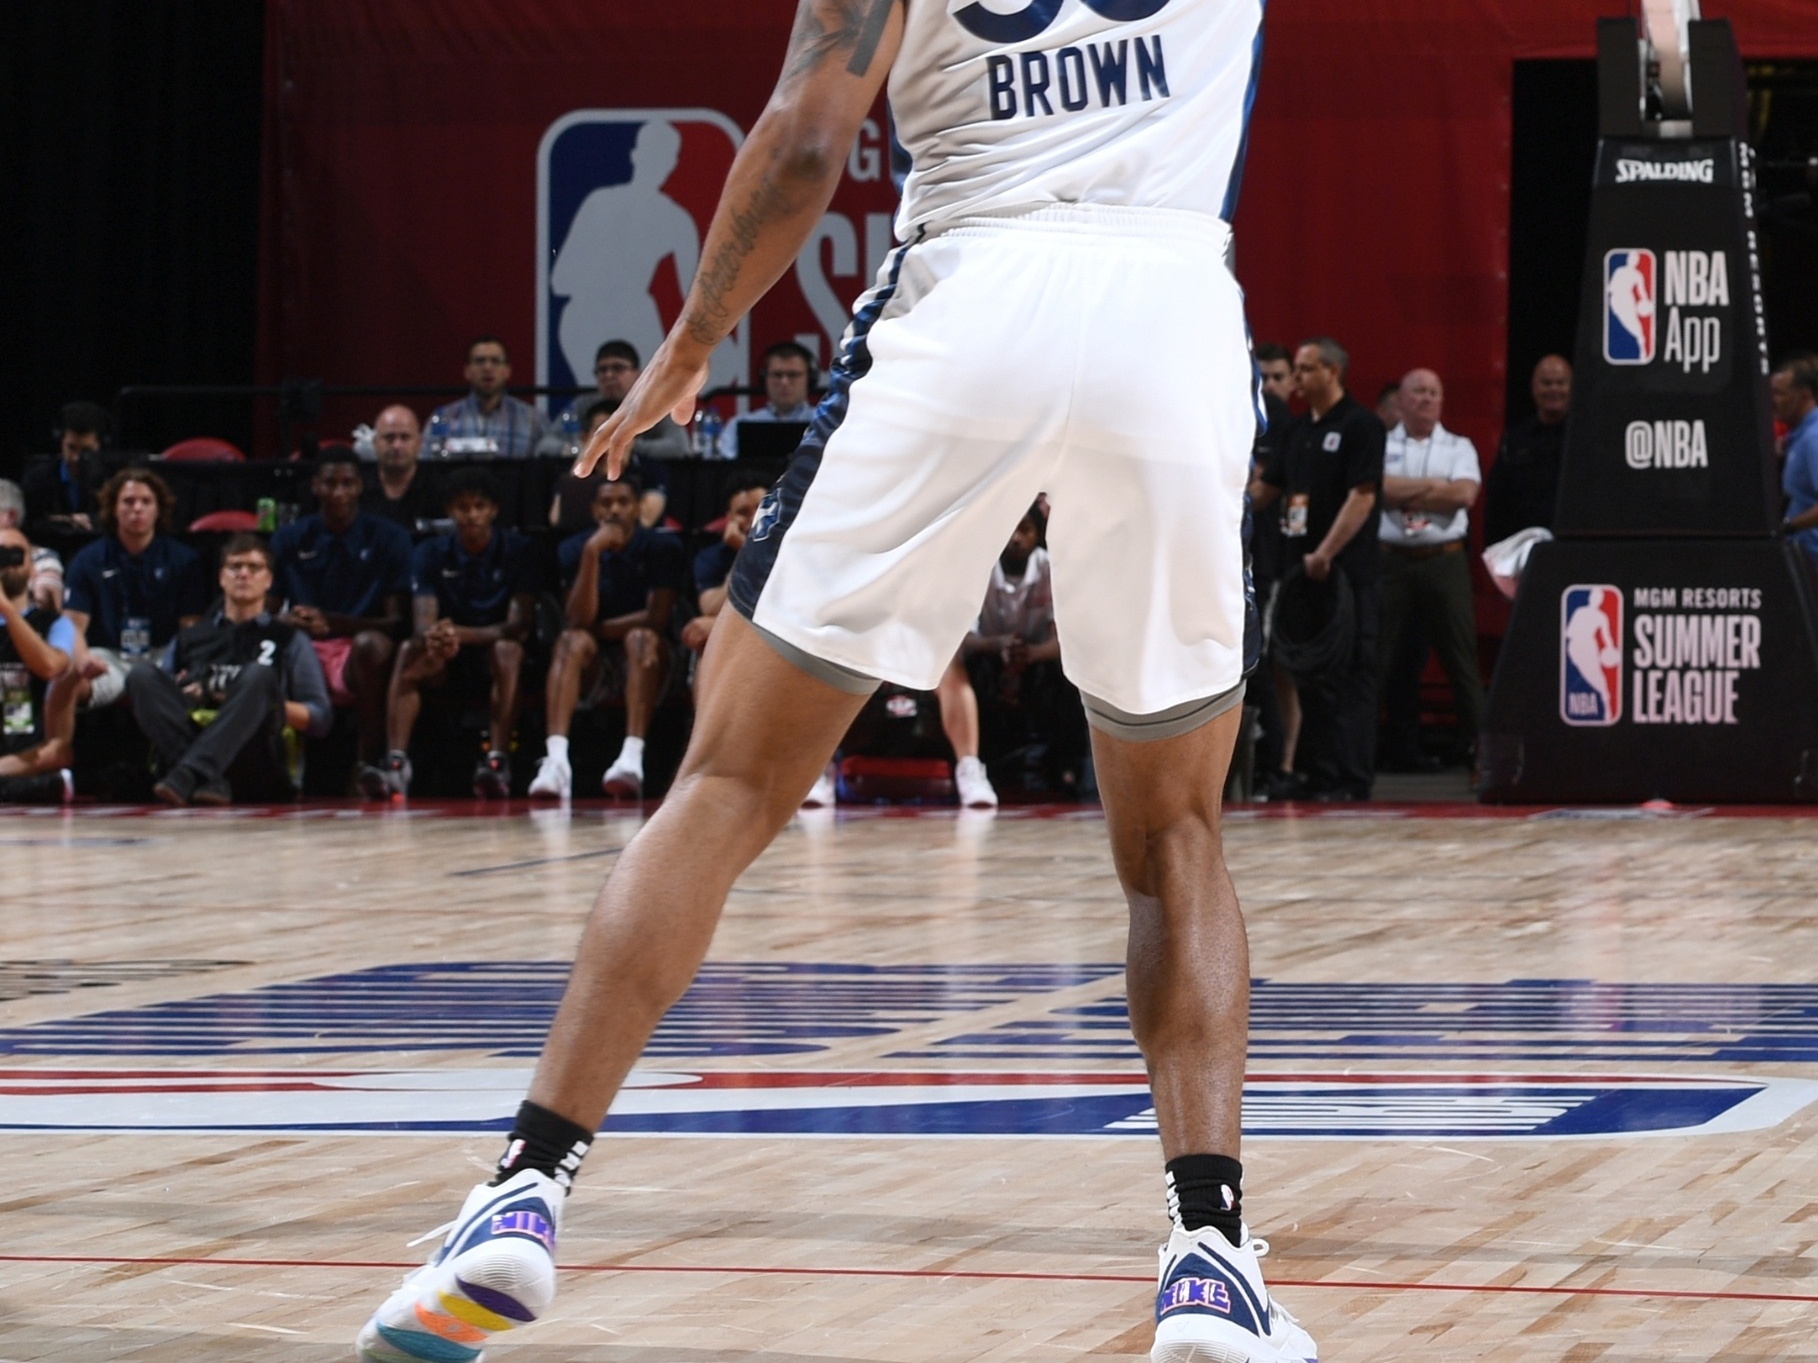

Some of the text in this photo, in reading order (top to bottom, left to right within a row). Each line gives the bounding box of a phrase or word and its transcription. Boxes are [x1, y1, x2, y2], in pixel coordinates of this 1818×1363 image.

[986, 34, 1171, 121] BROWN
[1615, 158, 1714, 184] SPALDING
[1664, 250, 1730, 306] NBA
[1664, 306, 1721, 374] App
[1625, 420, 1709, 470] @NBA
[1633, 588, 1763, 610] MGM RESORTS
[256, 638, 277, 667] 2
[1632, 614, 1762, 669] SUMMER
[1568, 692, 1599, 716] NBA
[1632, 669, 1740, 724] LEAGUE
